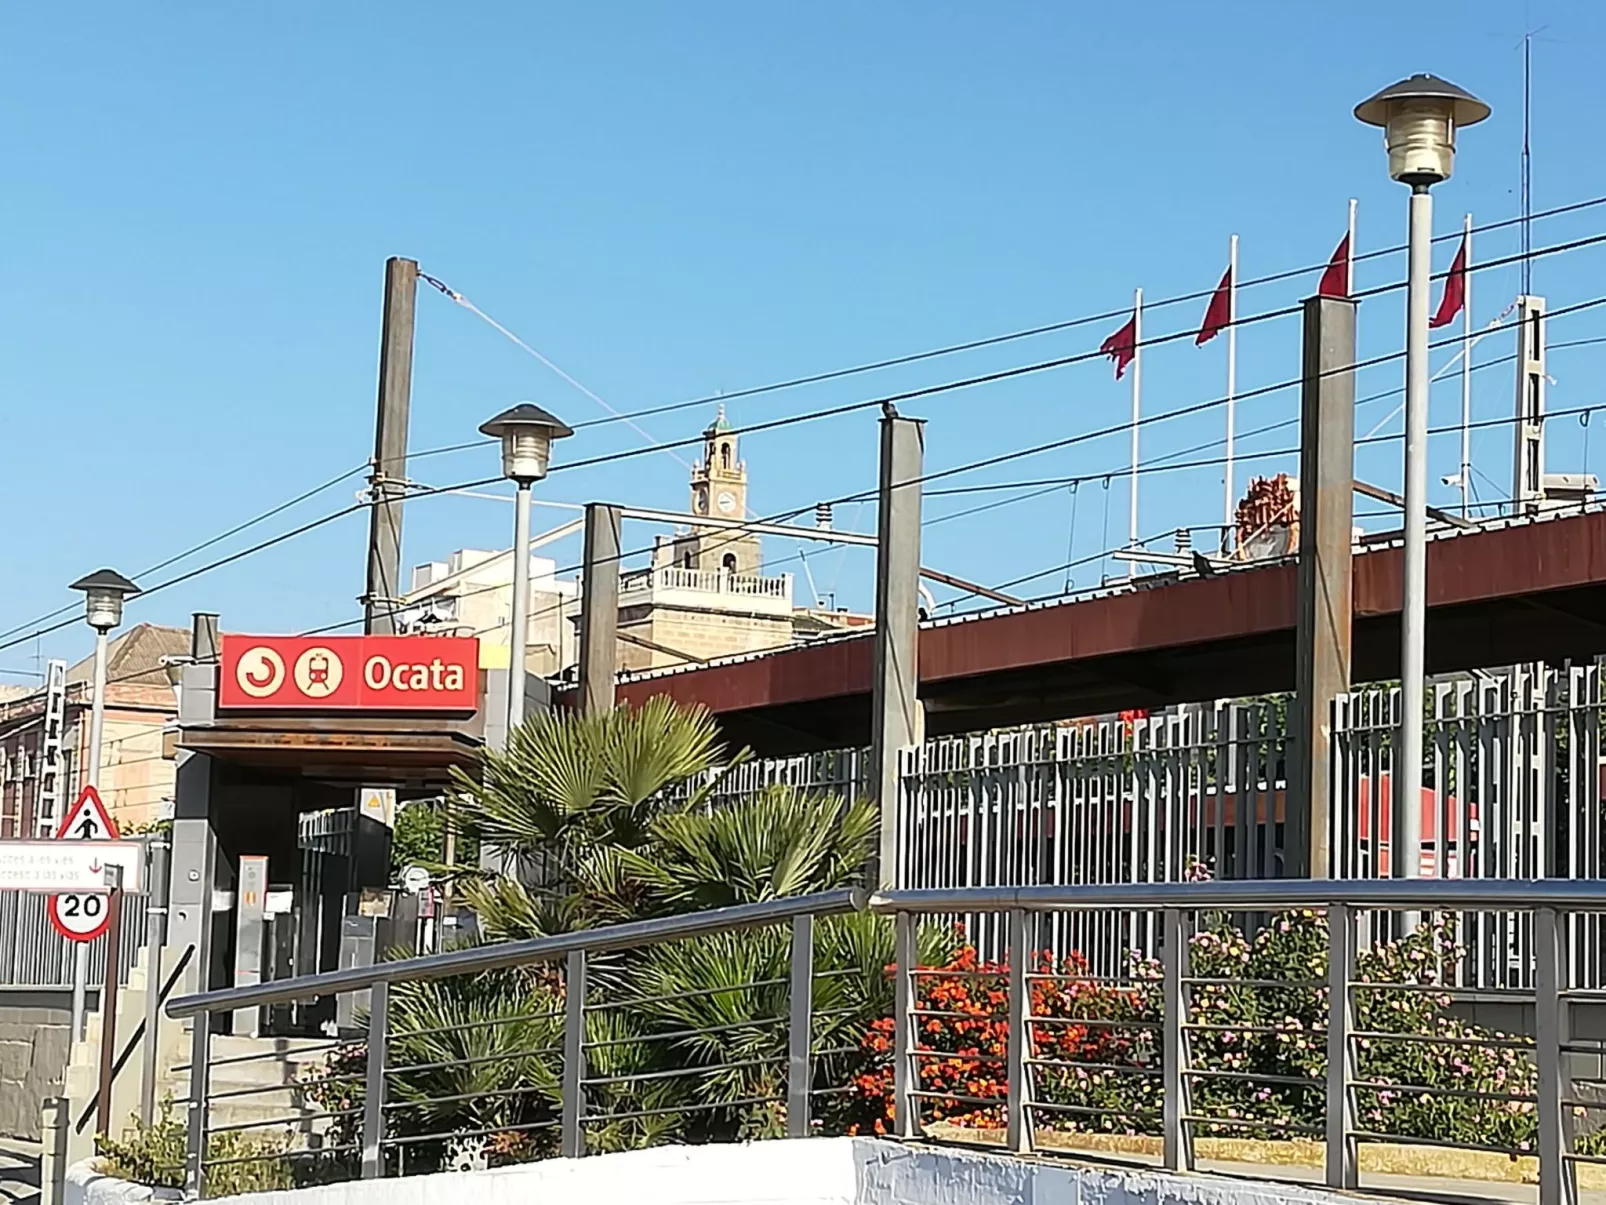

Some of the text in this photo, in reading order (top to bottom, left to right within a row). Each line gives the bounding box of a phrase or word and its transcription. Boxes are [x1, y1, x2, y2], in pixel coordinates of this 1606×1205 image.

[363, 655, 465, 692] Ocata
[0, 869, 31, 881] cceso
[64, 894, 101, 917] 20
